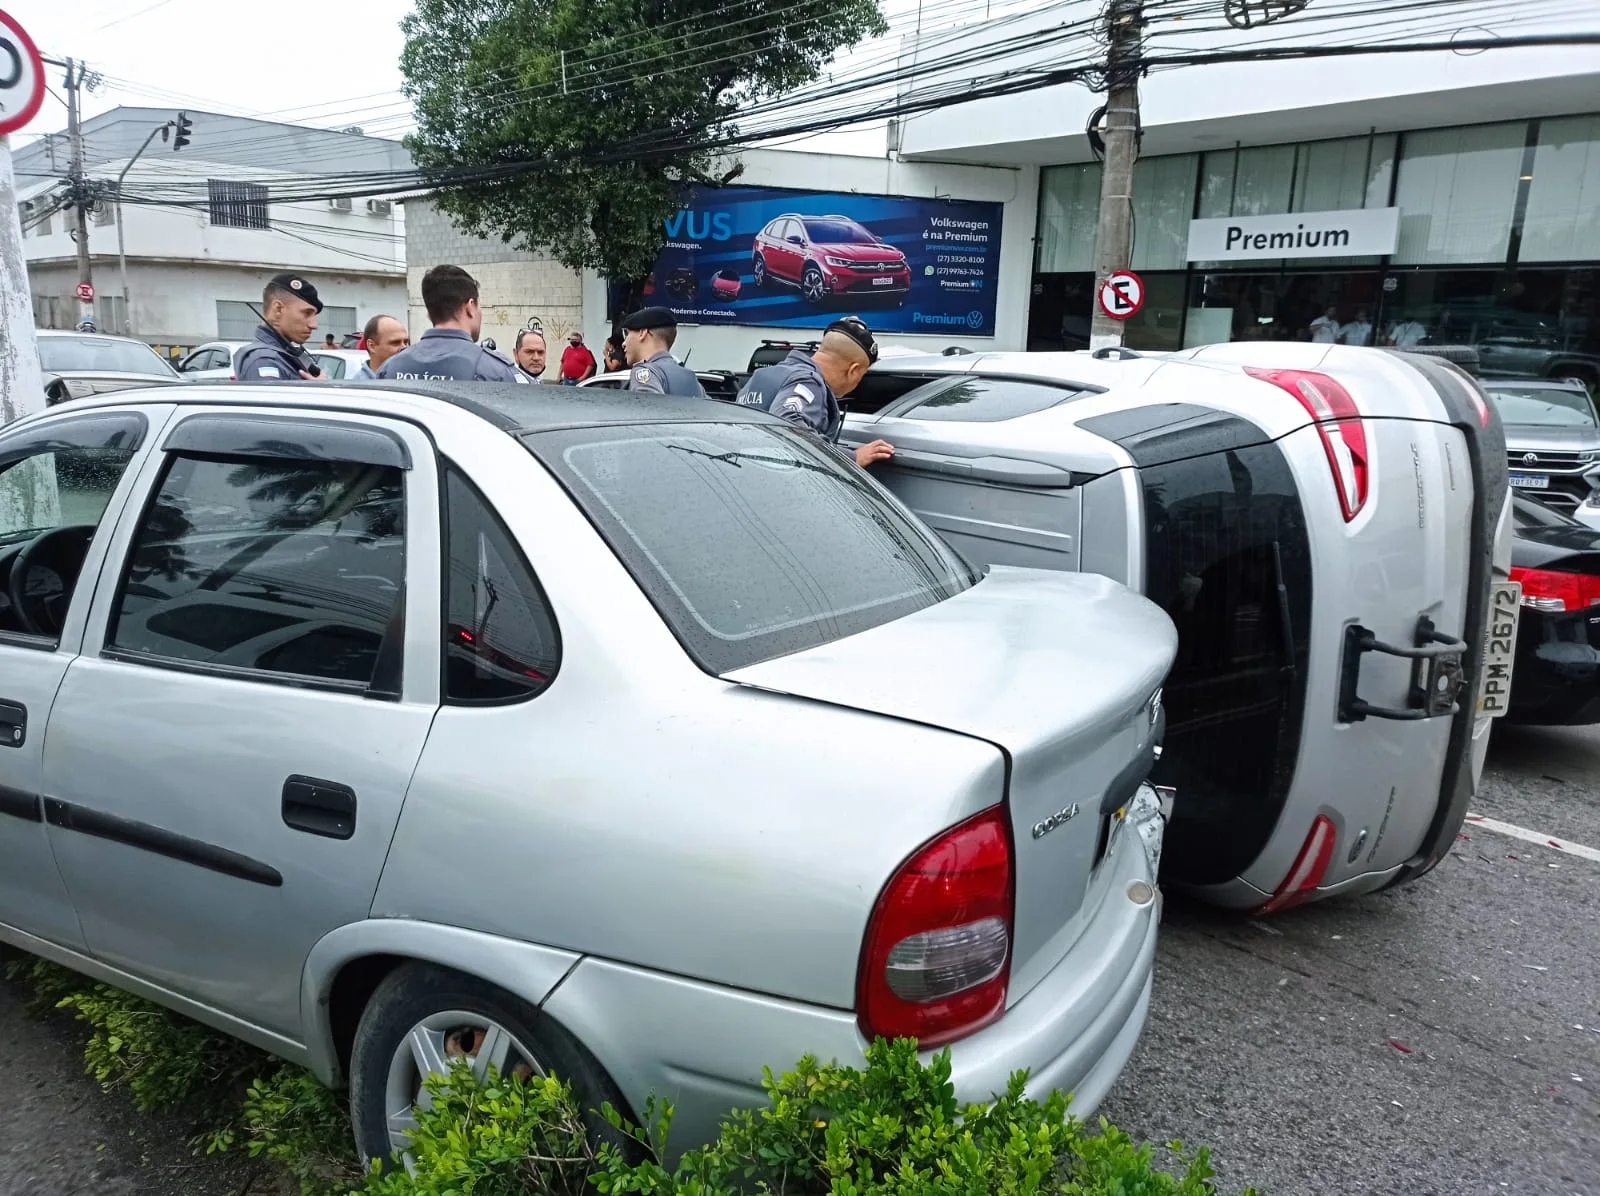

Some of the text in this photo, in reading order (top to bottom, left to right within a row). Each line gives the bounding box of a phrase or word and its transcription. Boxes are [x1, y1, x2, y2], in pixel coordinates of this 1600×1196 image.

[931, 217, 989, 230] Volkswagen
[922, 229, 988, 242] é na Premium
[1226, 224, 1350, 251] Premium
[665, 241, 702, 250] kswagen.
[937, 255, 950, 264] (27)
[940, 280, 969, 288] Premium
[1112, 281, 1132, 310] E
[913, 311, 966, 325] Premium
